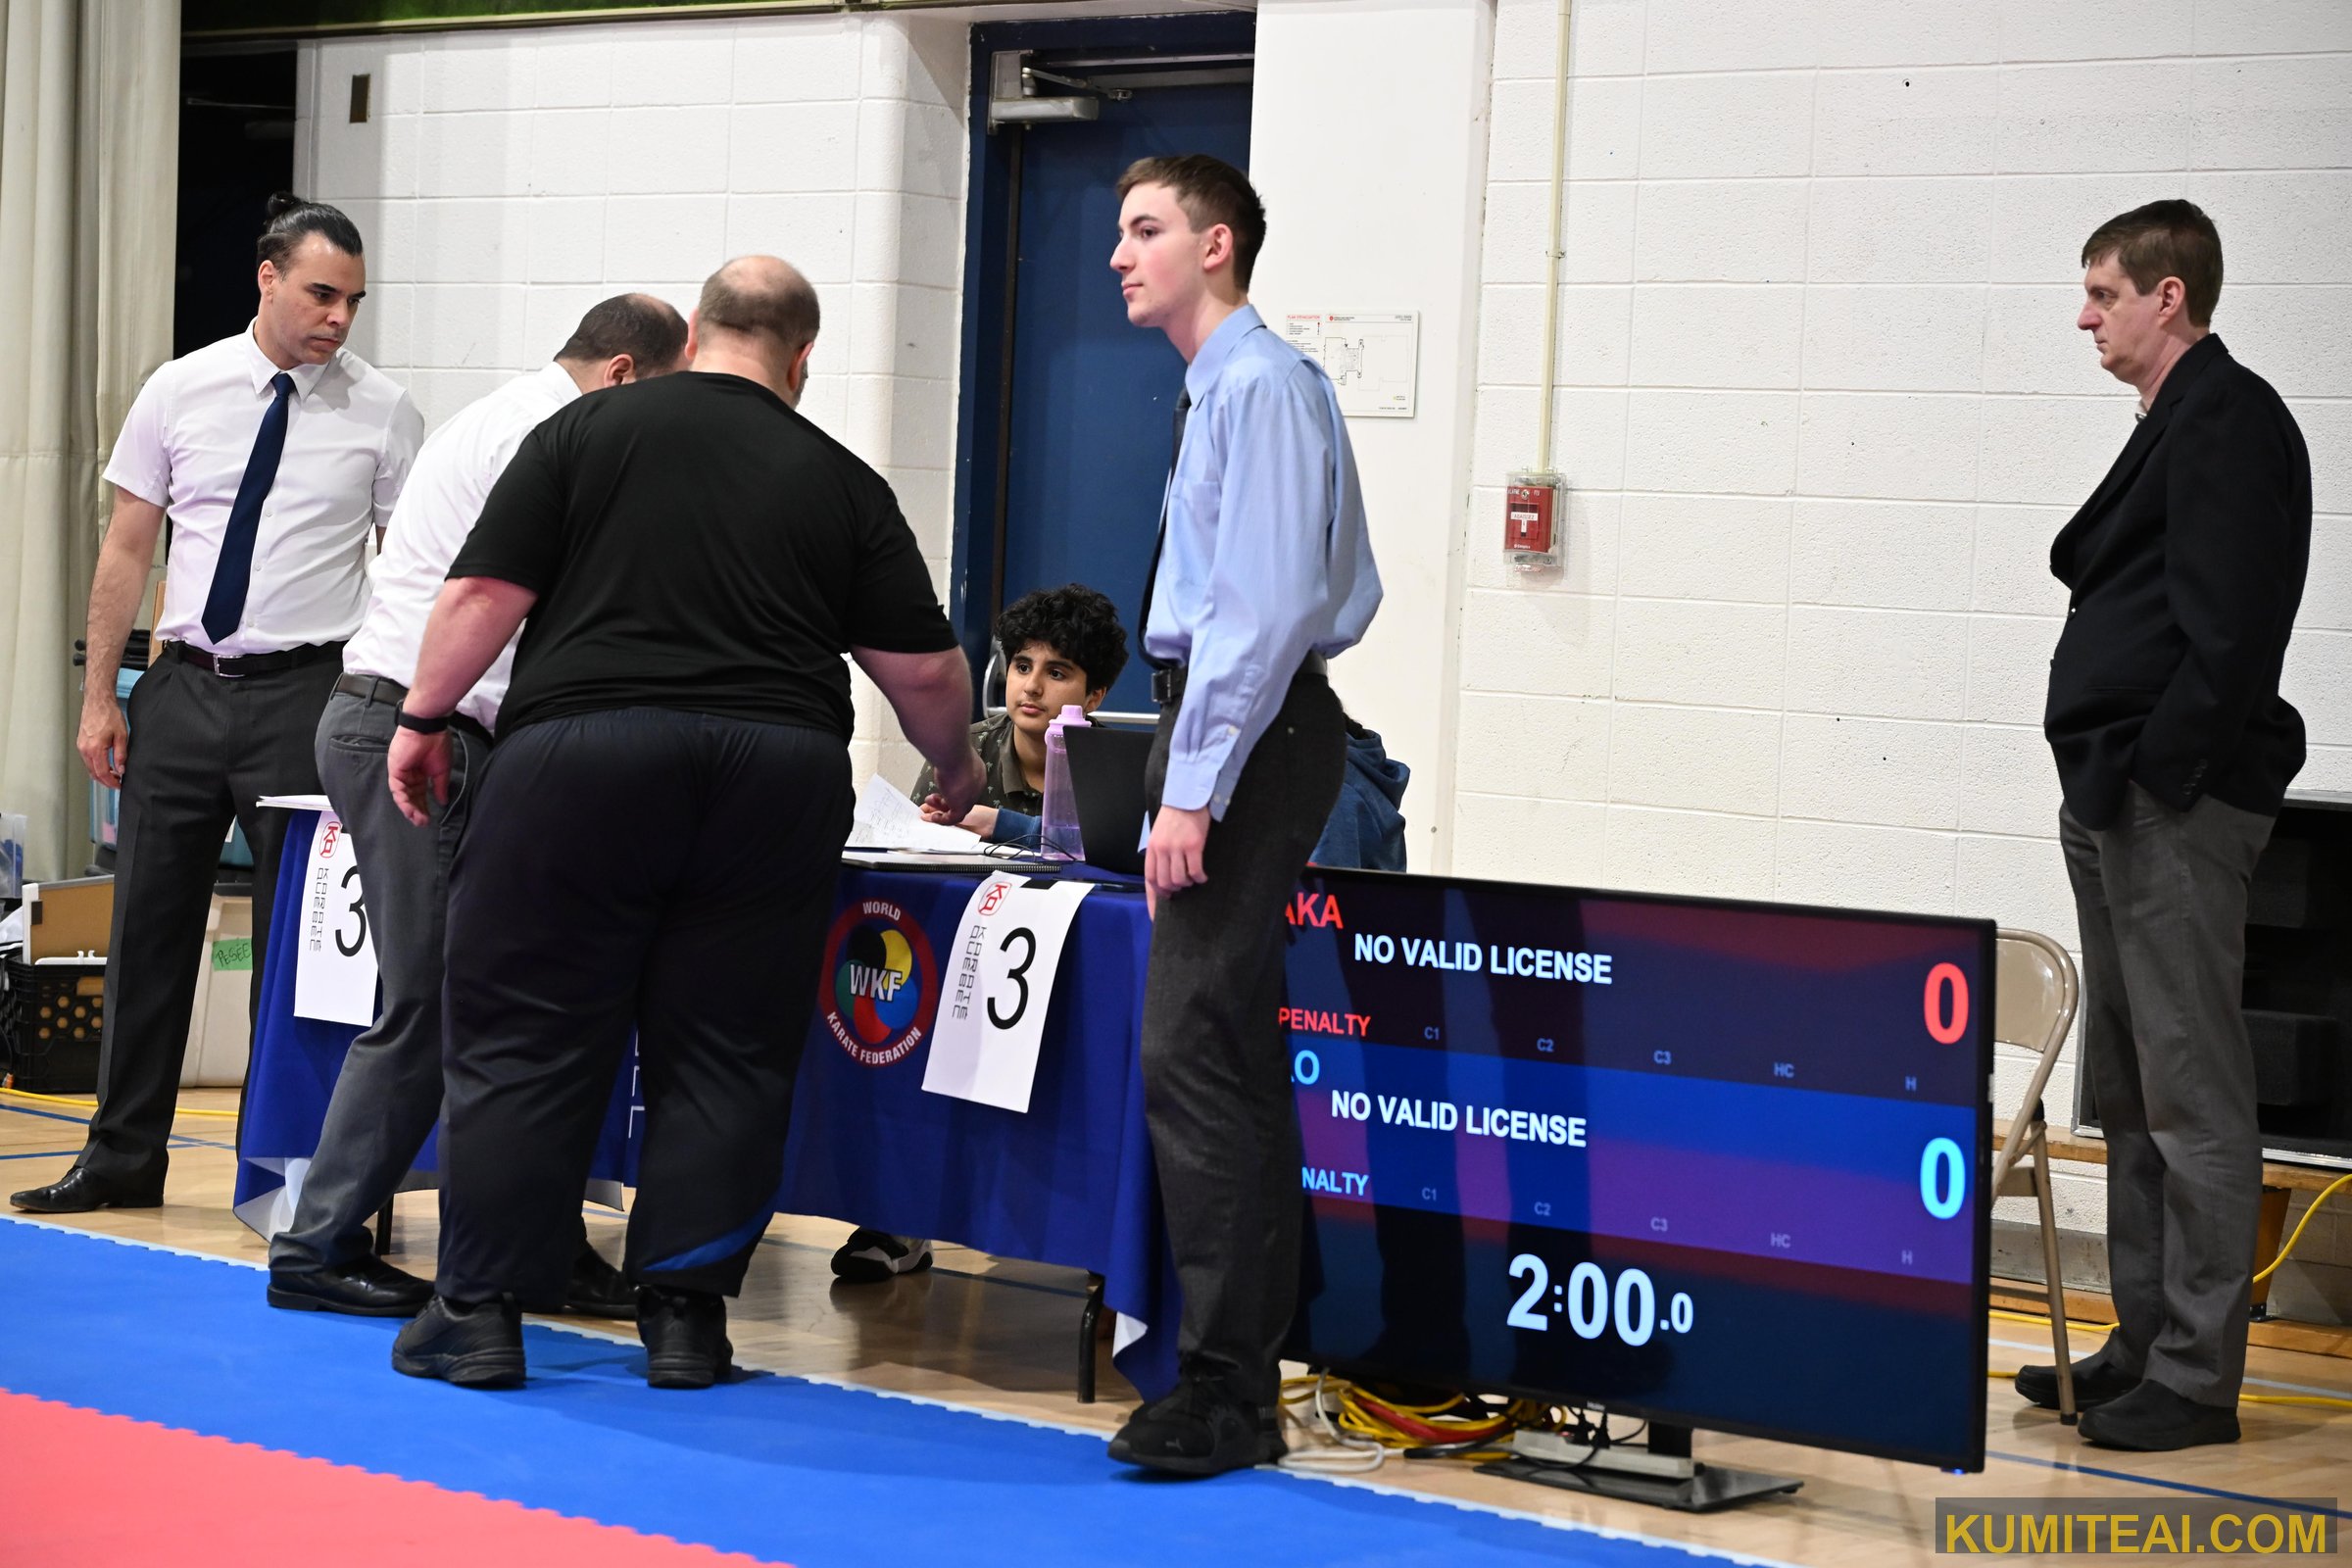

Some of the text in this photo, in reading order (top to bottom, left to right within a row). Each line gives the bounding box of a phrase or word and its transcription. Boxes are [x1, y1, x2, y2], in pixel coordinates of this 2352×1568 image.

[335, 865, 367, 957] 3
[862, 901, 902, 921] WORLD
[1354, 933, 1612, 985] NO VALID LICENSE
[850, 963, 903, 1002] WKF
[987, 926, 1037, 1030] 3
[1923, 961, 1970, 1045] 0
[1278, 1006, 1371, 1038] PENALTY
[1424, 1026, 1440, 1040] C1
[826, 1011, 922, 1065] KARATE FEDERATION
[1536, 1038, 1554, 1053] C2
[1291, 1050, 1320, 1085] O
[1653, 1050, 1672, 1065] C3
[1774, 1062, 1794, 1078] HC
[1905, 1076, 1917, 1091] H
[1331, 1089, 1587, 1148] NO VALID LICENSE
[1301, 1166, 1369, 1197] NALTY
[1421, 1187, 1437, 1200] C1
[1920, 1137, 1966, 1220] 0
[1534, 1201, 1551, 1216] C2
[1650, 1216, 1669, 1232] C3
[1770, 1232, 1791, 1249] HC
[1901, 1250, 1913, 1265] H
[1506, 1253, 1693, 1347] 2:00.0
